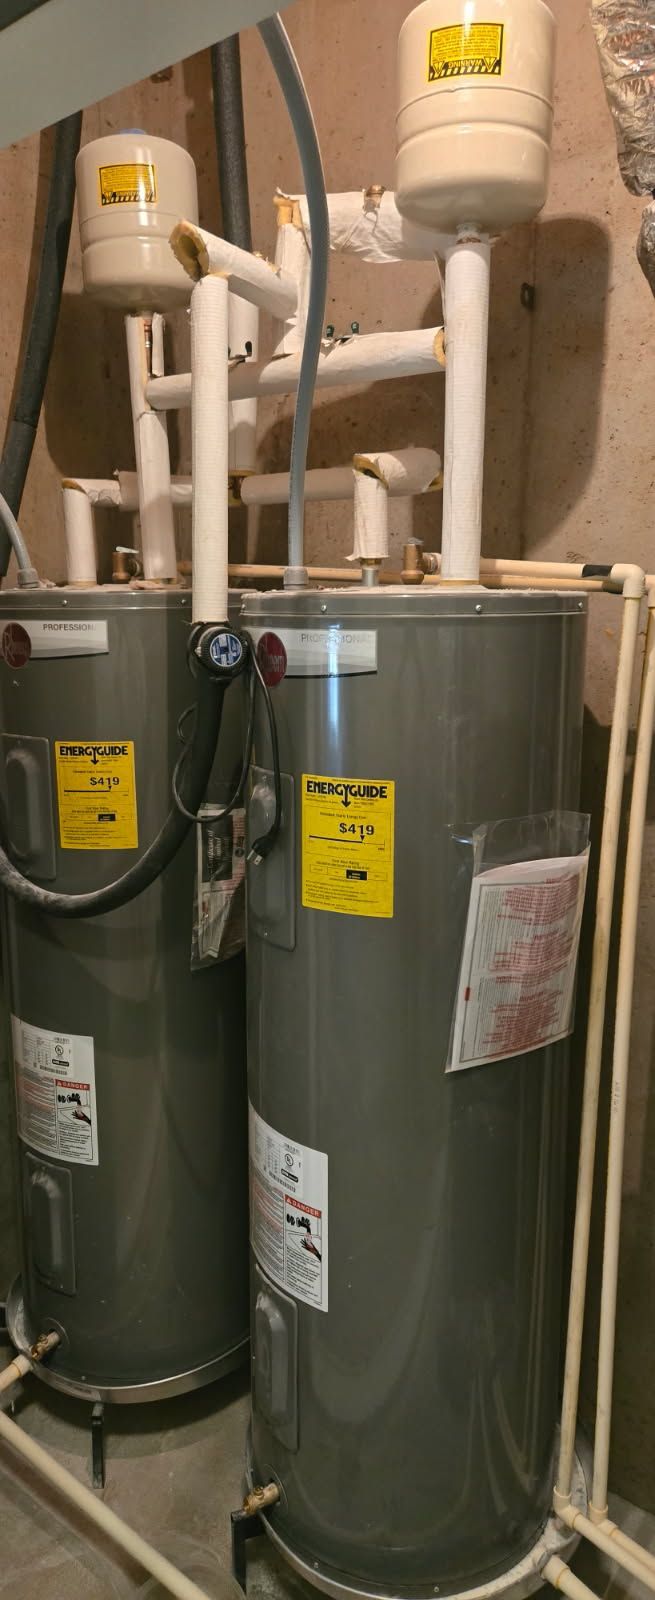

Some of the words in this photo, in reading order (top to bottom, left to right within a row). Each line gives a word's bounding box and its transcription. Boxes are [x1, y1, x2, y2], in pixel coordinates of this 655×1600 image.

[447, 58, 483, 69] WARNING
[43, 623, 96, 631] PROFESSION
[59, 745, 129, 757] ENERGYGUIDE
[89, 776, 120, 786] $419
[306, 780, 388, 799] ENERGYGUIDE
[339, 822, 375, 836] $419
[292, 1200, 319, 1217] DANGER
